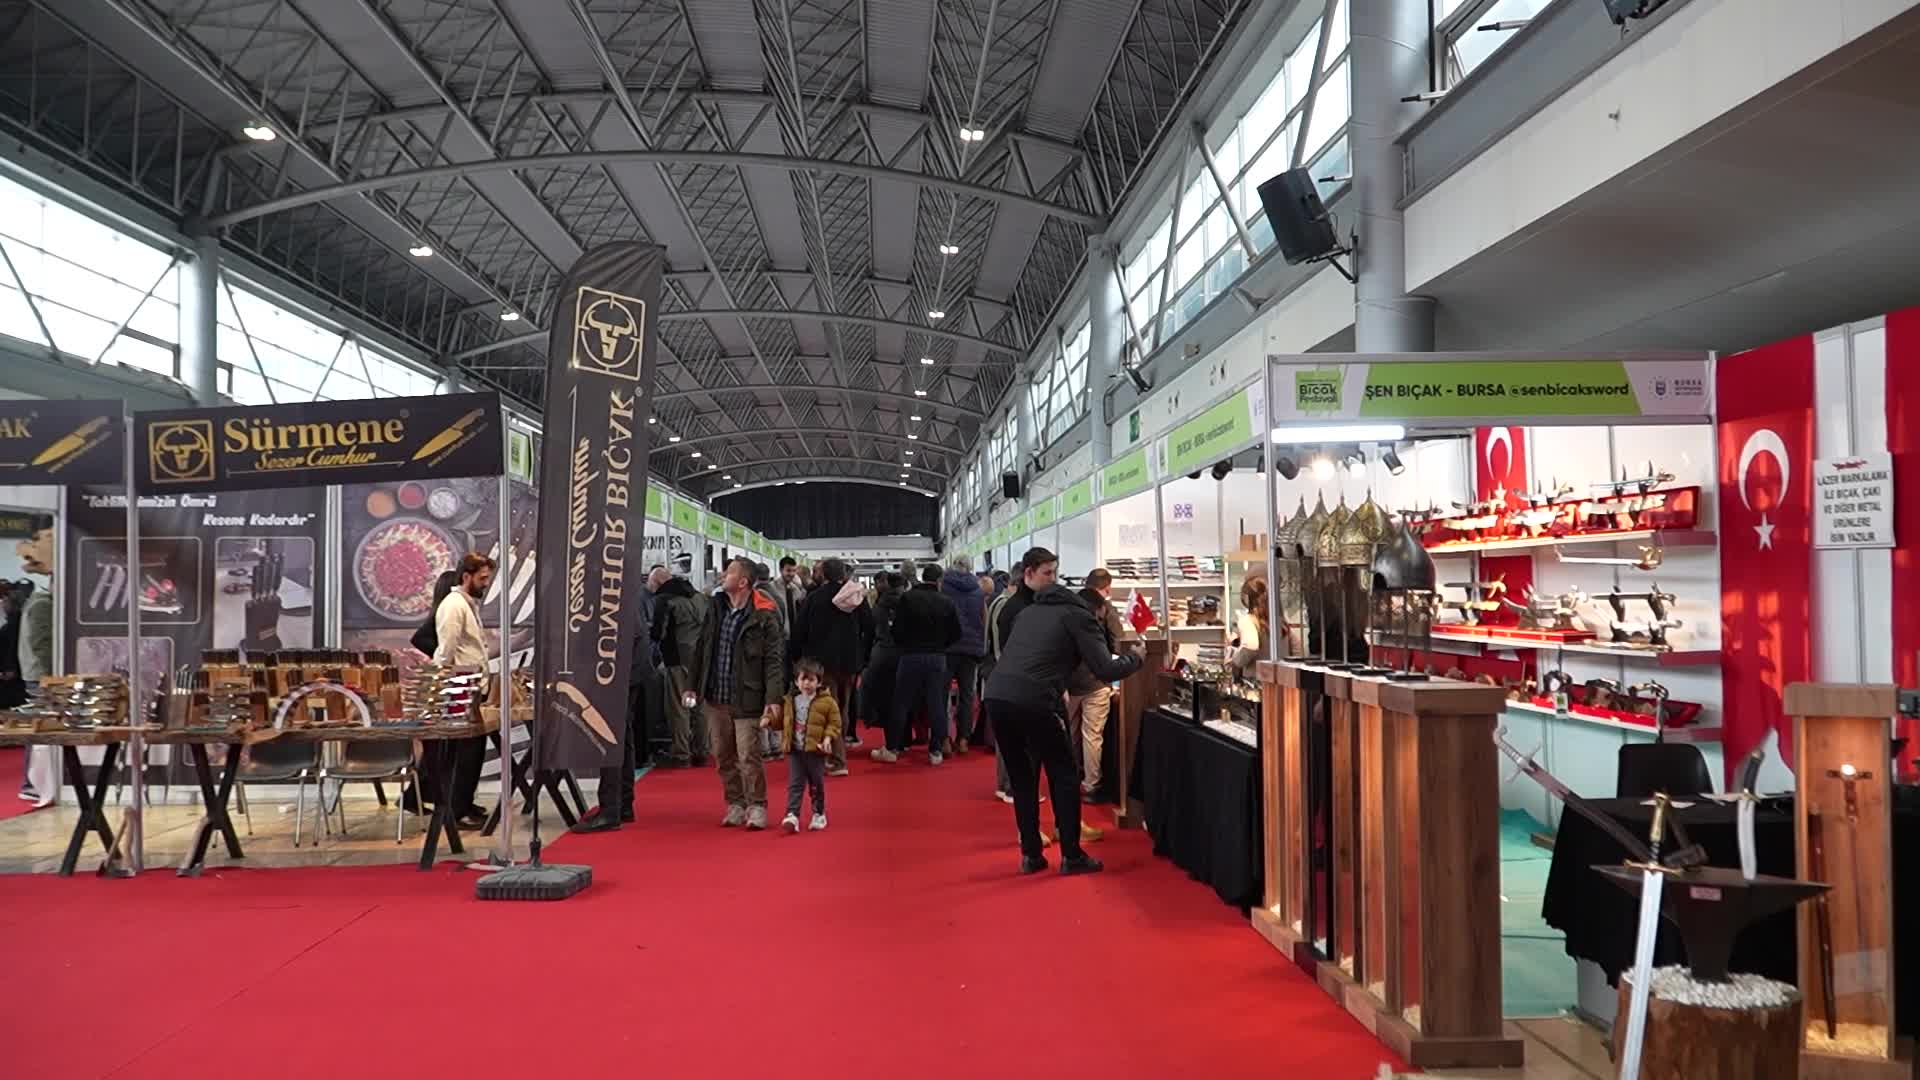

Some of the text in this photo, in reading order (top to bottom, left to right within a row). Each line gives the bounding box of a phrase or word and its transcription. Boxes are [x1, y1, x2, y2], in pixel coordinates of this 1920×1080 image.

[1365, 384, 1393, 401] ŞEN
[1396, 384, 1442, 401] BIÇAK
[1456, 383, 1506, 397] BURSA
[223, 416, 405, 454] Sürmene
[306, 444, 377, 466] Cumhur
